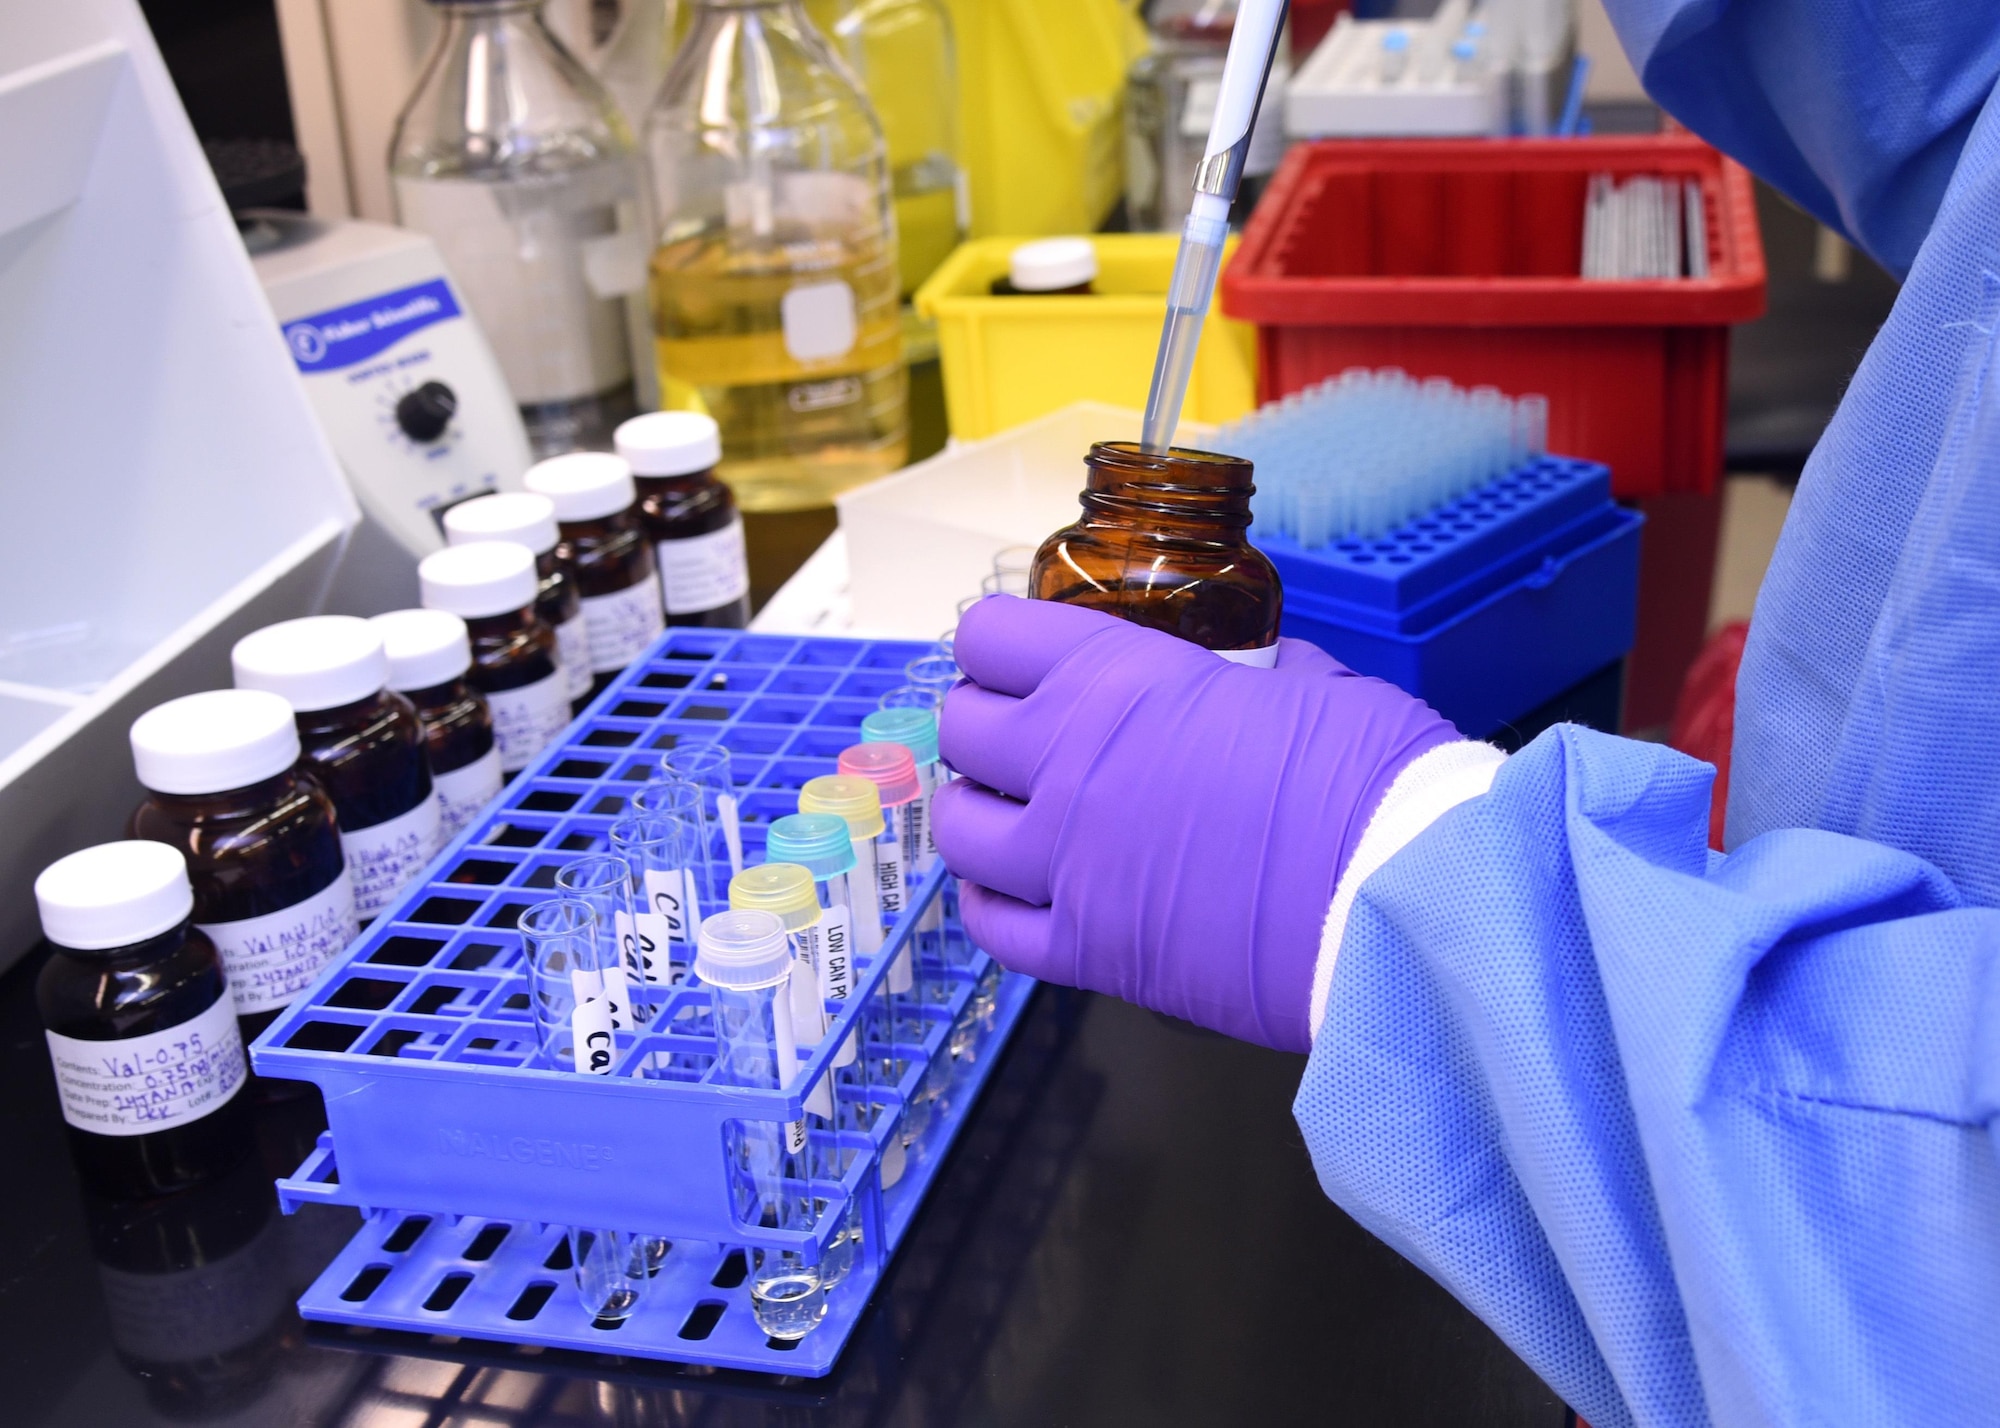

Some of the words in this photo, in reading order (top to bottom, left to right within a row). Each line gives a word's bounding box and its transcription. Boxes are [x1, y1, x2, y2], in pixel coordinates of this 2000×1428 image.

[880, 861, 898, 890] HIGH
[828, 924, 844, 952] LOW
[829, 957, 846, 981] CAN
[586, 1030, 611, 1076] Ca
[55, 1056, 99, 1075] Contents:
[59, 1072, 135, 1092] Concentration:
[63, 1089, 83, 1103] Date
[66, 1103, 109, 1122] Prepared
